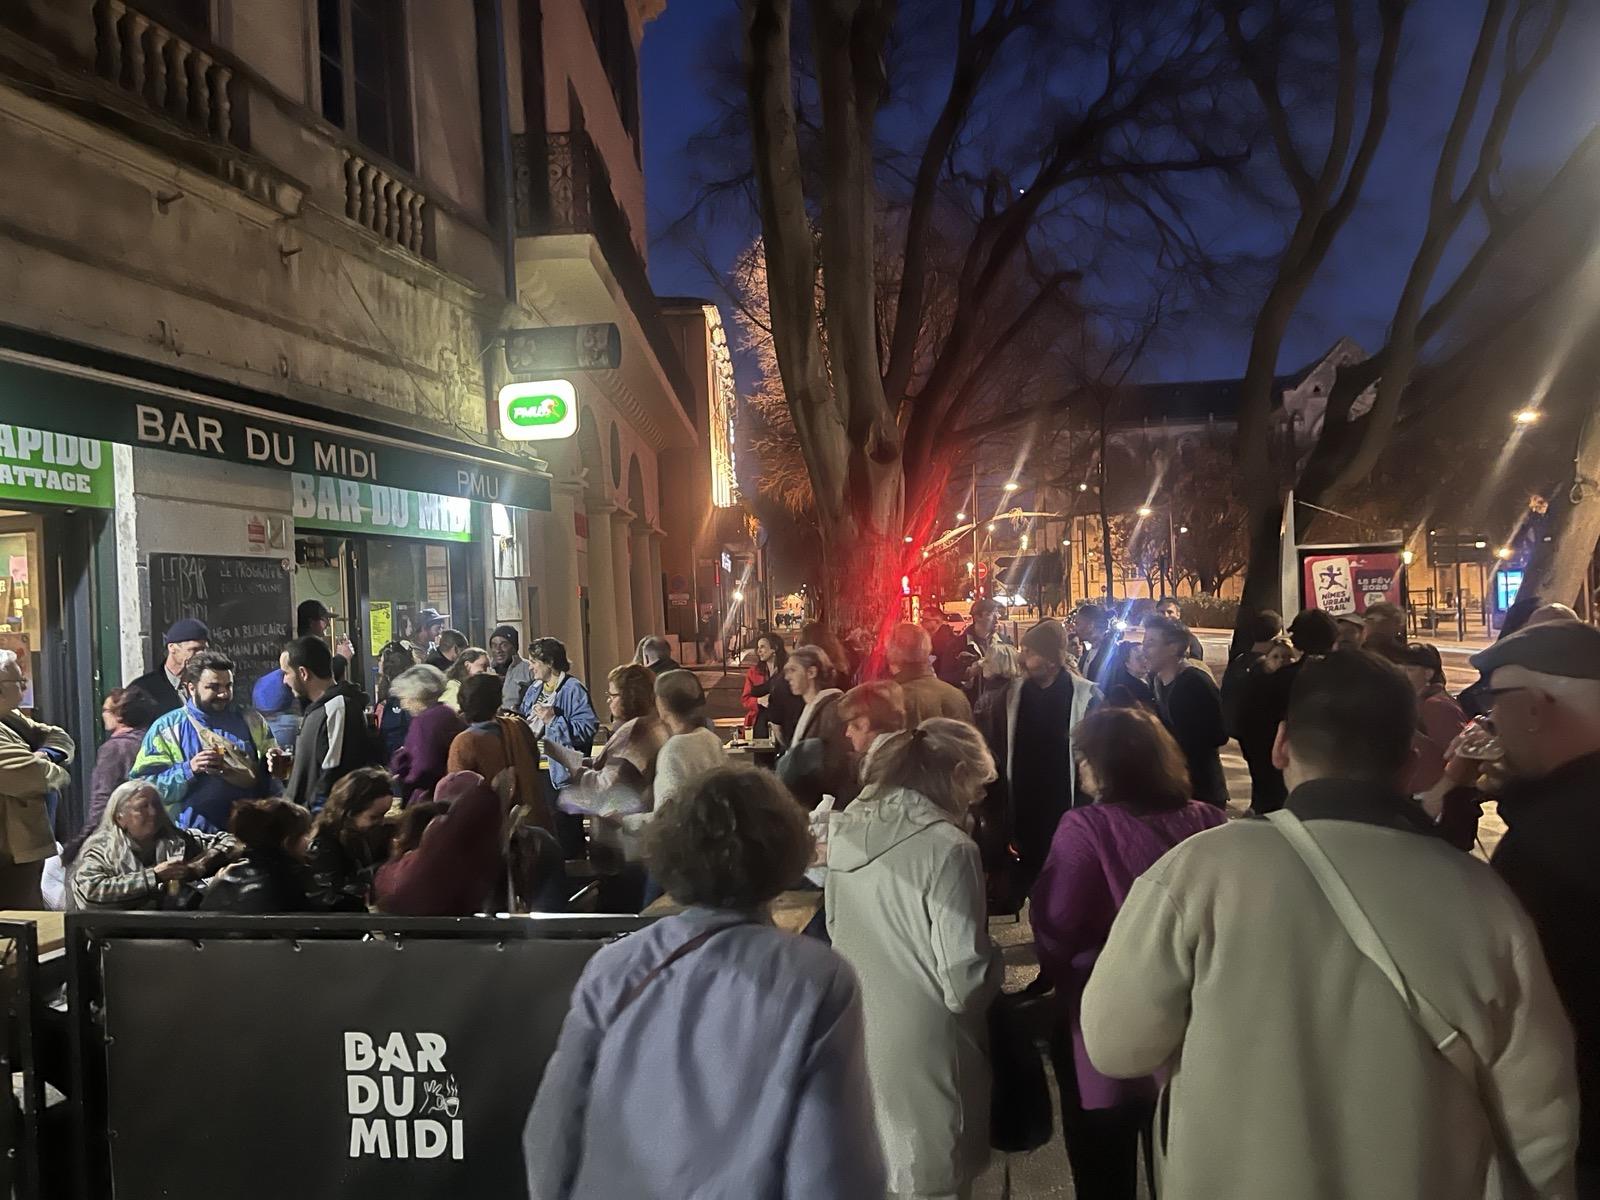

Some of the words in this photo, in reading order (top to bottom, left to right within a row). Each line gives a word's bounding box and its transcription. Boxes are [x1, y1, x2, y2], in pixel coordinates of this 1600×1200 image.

[136, 404, 224, 454] BAR
[245, 426, 295, 466] DU
[314, 441, 377, 480] MIDI
[0, 463, 92, 494] ATTAGE
[457, 471, 499, 500] PMU
[291, 472, 362, 524] BAR
[371, 484, 410, 528] DU
[418, 491, 472, 533] MIDI
[179, 555, 208, 601] BAR
[1323, 596, 1350, 606] URBAN
[1324, 604, 1346, 612] TRAIL
[344, 1032, 447, 1073] BAR
[347, 1075, 415, 1117] DU
[350, 1118, 464, 1160] MIDI
